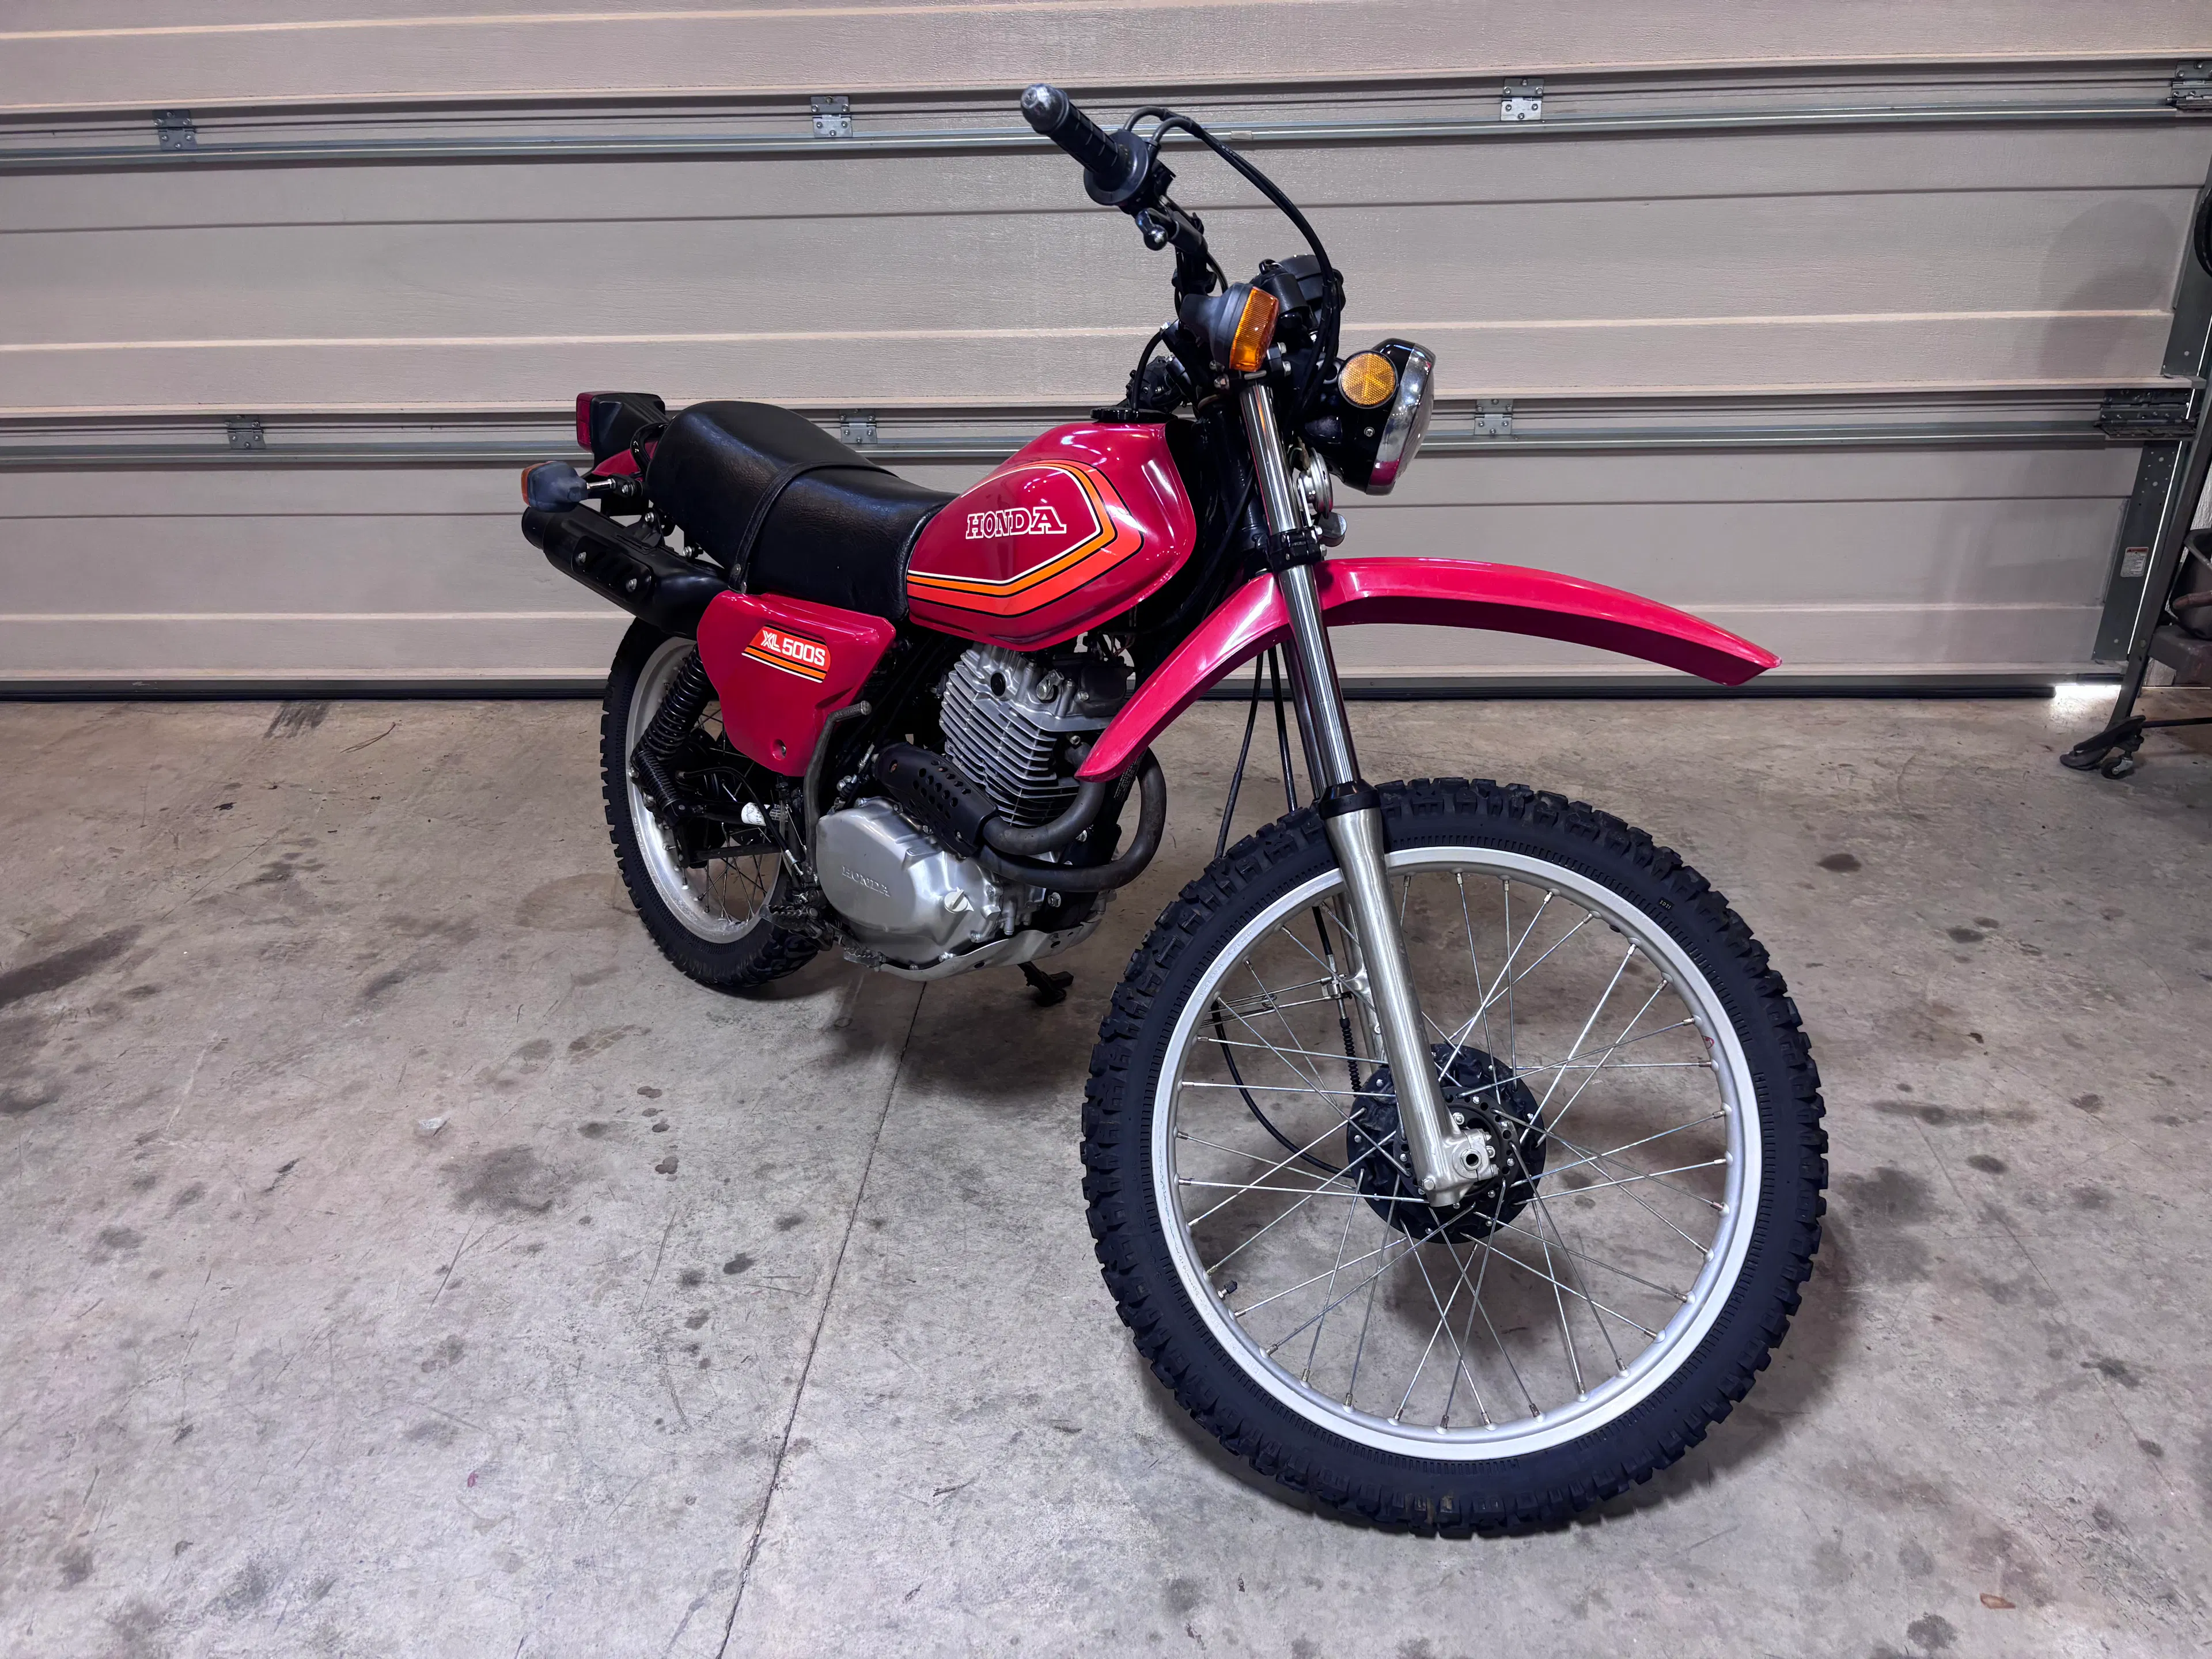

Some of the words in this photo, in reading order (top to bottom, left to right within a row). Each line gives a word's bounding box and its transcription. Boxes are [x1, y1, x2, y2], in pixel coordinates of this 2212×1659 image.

[965, 506, 1066, 539] HONDA
[761, 630, 781, 653] XL
[782, 638, 825, 666] 500S
[842, 865, 892, 897] HONDA
